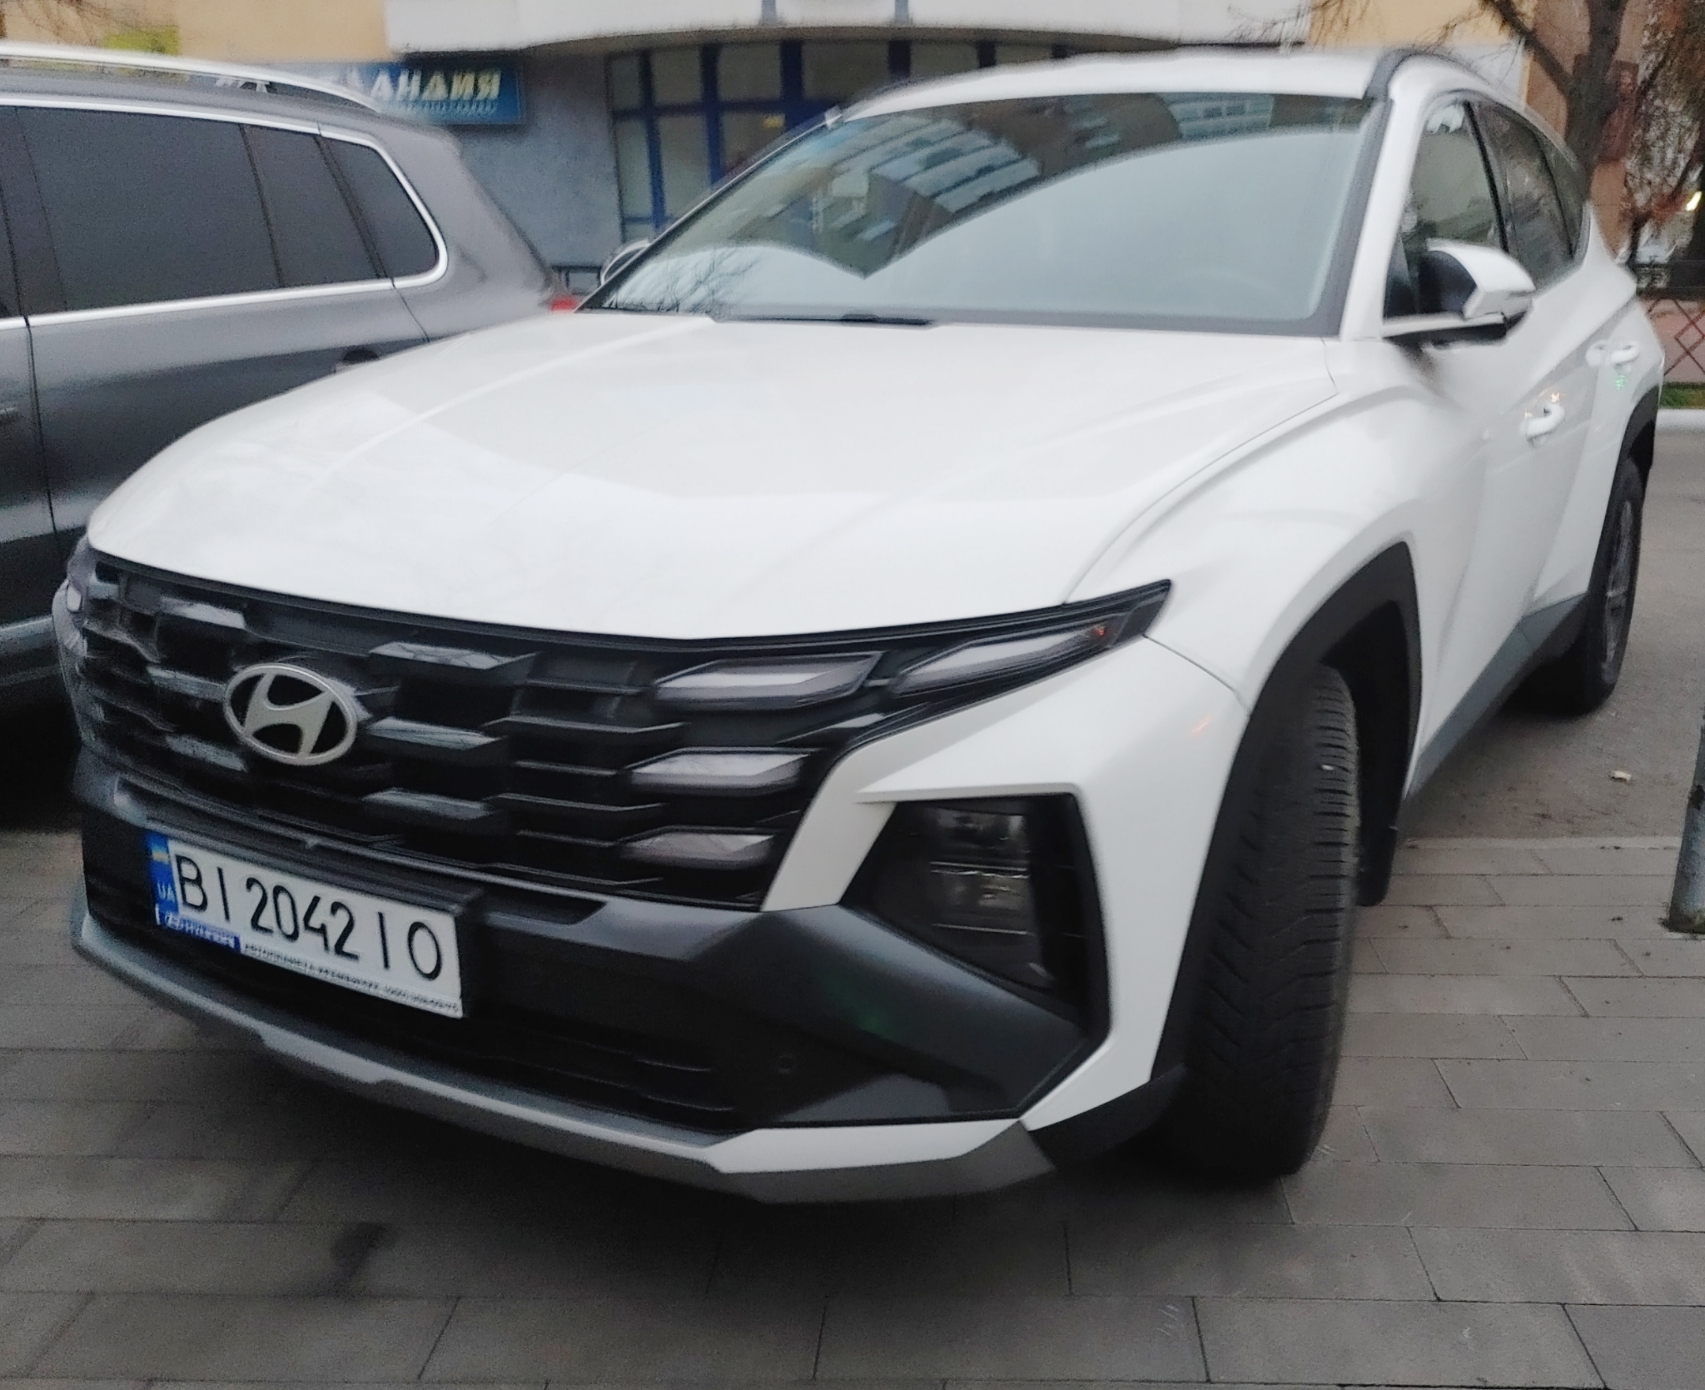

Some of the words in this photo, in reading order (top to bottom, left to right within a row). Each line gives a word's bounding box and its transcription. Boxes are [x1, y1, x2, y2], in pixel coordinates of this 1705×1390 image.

[157, 881, 176, 903] UA
[175, 853, 231, 922] BI
[245, 876, 360, 962] 2042
